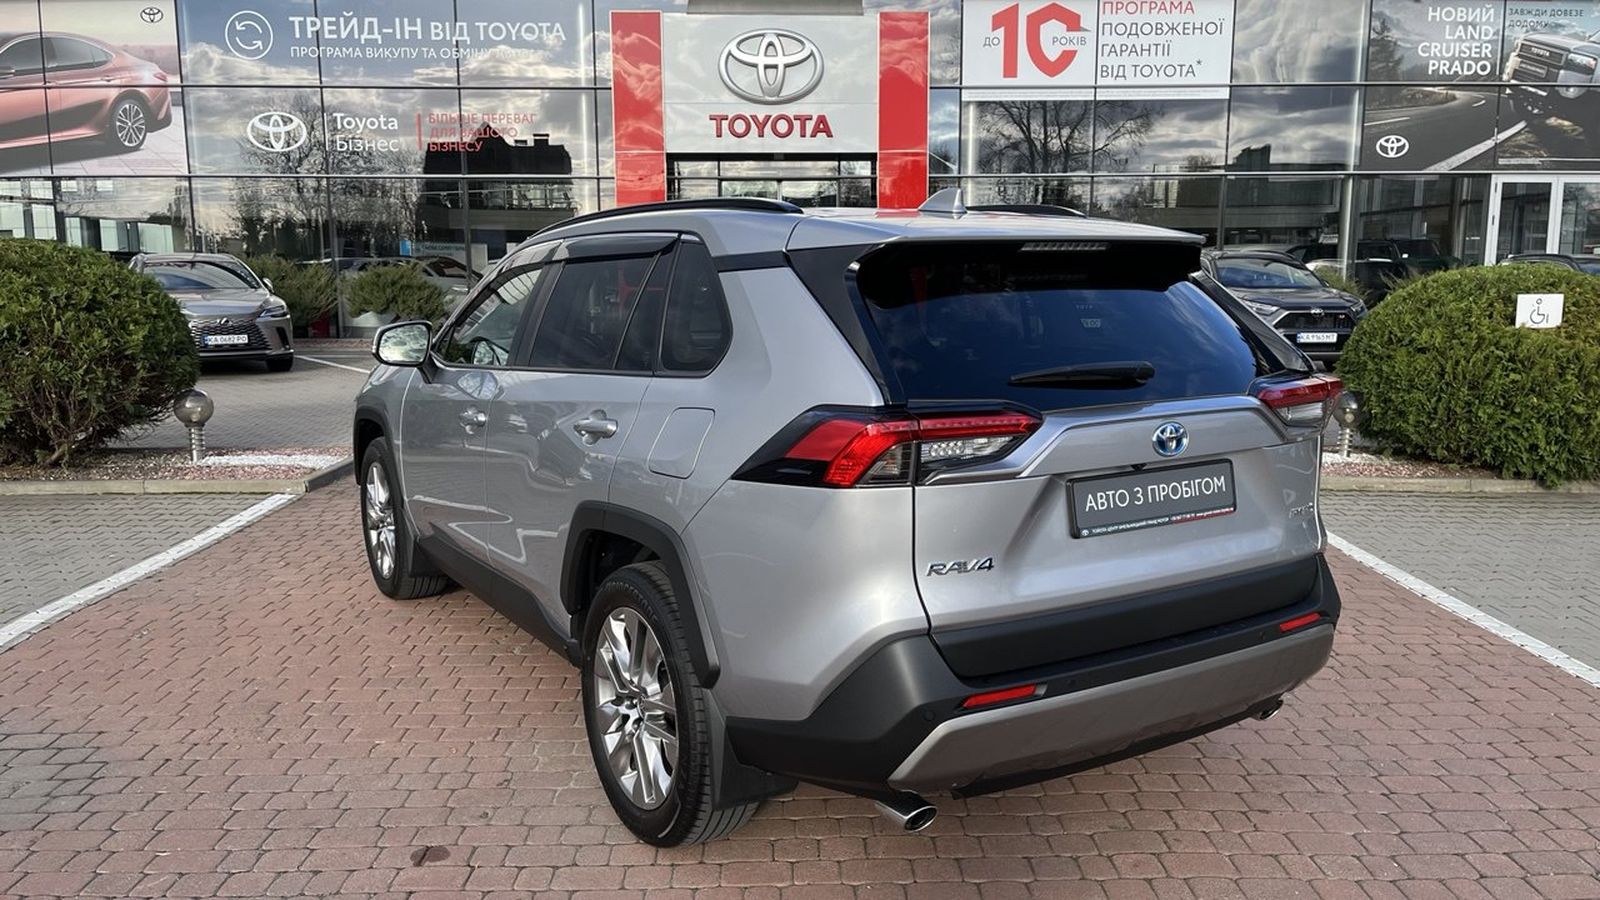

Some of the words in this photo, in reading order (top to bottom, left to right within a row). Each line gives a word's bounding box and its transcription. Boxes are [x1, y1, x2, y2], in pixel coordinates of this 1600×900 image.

[1102, 1, 1195, 15] ПРОГРАМА
[1428, 4, 1494, 22] НОВИЙ
[1509, 8, 1547, 17] ЗАВЖДИ
[1549, 9, 1584, 17] ДОВЕЗЕ
[288, 11, 422, 44] ТРЕЙД-ІН
[430, 21, 470, 44] ВІД
[475, 22, 566, 41] TOYOTA
[1101, 18, 1225, 38] ПОДОВЖЕНОЇ
[1445, 25, 1493, 40] LAND
[983, 37, 1001, 47] ДО
[1052, 36, 1087, 46] РОКІВ
[1101, 40, 1172, 57] ГАРАНТІЇ
[290, 46, 363, 58] ПРОГРАМА
[366, 47, 418, 59] ВИКУПУ
[422, 48, 437, 58] ТА
[1418, 42, 1492, 58] CRUISER
[1100, 64, 1126, 80] ВІД
[1428, 60, 1491, 76] PRADO
[333, 113, 398, 133] Toyota
[482, 113, 536, 123] ПЕРЕВАГ
[709, 113, 833, 138] TOYOTA
[336, 134, 399, 152] Бізнес
[429, 141, 482, 152] БІЗНЕСУ
[1085, 489, 1130, 512] АВТО
[1134, 486, 1144, 505] З
[1148, 475, 1226, 504] ПРОБІГОМ
[926, 556, 994, 577] RAV4
